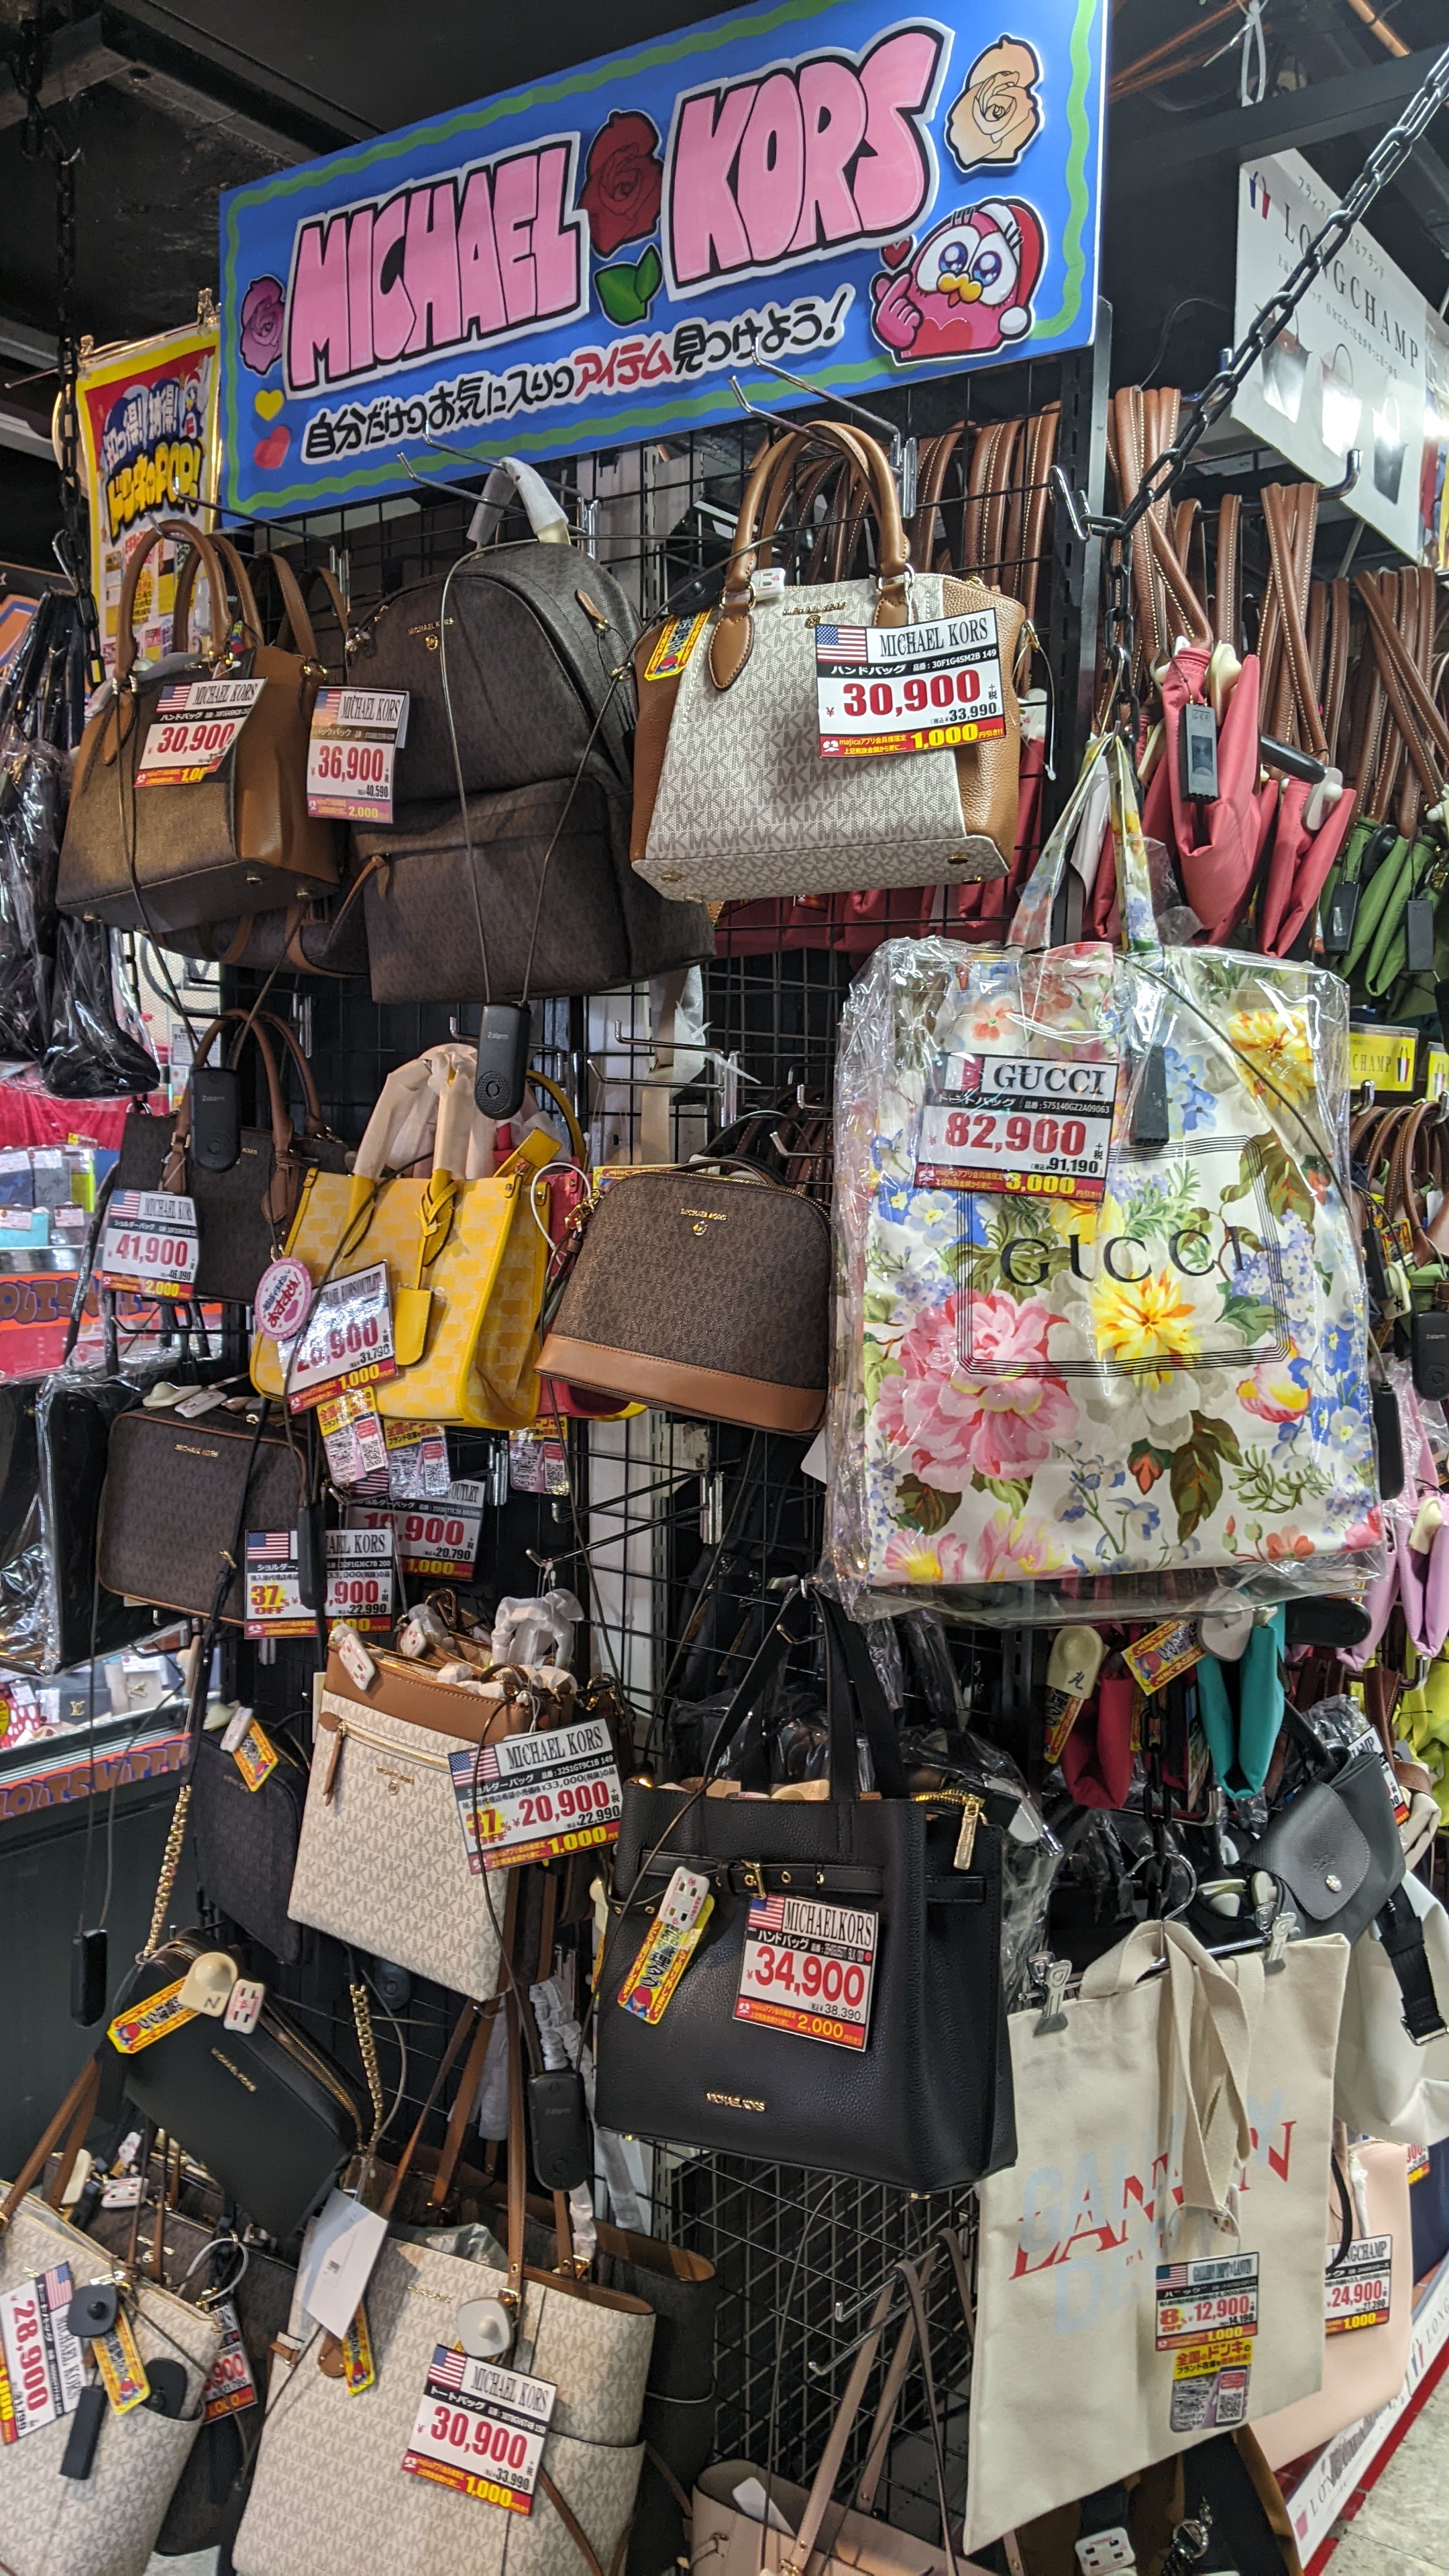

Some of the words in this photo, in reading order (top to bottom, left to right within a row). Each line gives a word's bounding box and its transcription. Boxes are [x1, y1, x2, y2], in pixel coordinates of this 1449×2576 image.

[289, 142, 581, 391] MICHAEL
[673, 28, 941, 286] KORS
[436, 616, 457, 628] KRS
[880, 627, 945, 657] MICHAEL
[948, 617, 988, 645] KORS
[831, 663, 906, 676] ハンドバッグ
[193, 685, 229, 705] MICHAEL
[230, 684, 258, 702] KORS
[341, 695, 374, 720] MICHAEL
[376, 699, 401, 722] KORS
[843, 669, 981, 718] 30,900
[160, 712, 203, 722] ハンドバッグ
[157, 722, 235, 755] 30,900
[911, 723, 978, 750] 1,000
[317, 745, 384, 782] 36,900
[348, 805, 380, 818] 2,000
[994, 1065, 1106, 1095] GUCCI
[945, 1112, 1087, 1157] 82,900
[1005, 1173, 1076, 1195] 3,000
[115, 1234, 189, 1267] 41,900
[145, 1280, 180, 1297] 2,000
[297, 1316, 378, 1374] 2,900
[354, 1534, 386, 1554] KORS
[256, 1564, 299, 1572] ショルダー
[251, 1585, 279, 1607] 37
[324, 1580, 379, 1607] ,900
[506, 1737, 566, 1770] MICHAEL
[566, 1726, 603, 1756] KORS
[518, 1780, 610, 1827] 20,900
[548, 1826, 607, 1854] 1,000
[784, 1900, 873, 1947] MICHAELKORS
[757, 1929, 810, 1951] ハンドバッグ
[755, 1945, 865, 2007] 34,900
[1332, 2279, 1383, 2309] 24,900
[1160, 2308, 1179, 2325] 8
[1194, 2295, 1250, 2322] 12,900
[13, 2299, 49, 2412] 28,900
[430, 2385, 486, 2410] トートバッグ
[471, 2365, 518, 2403] MICHAEL
[518, 2381, 550, 2413] KORS
[430, 2406, 528, 2469] 30,900
[466, 2475, 513, 2508] 1,000
